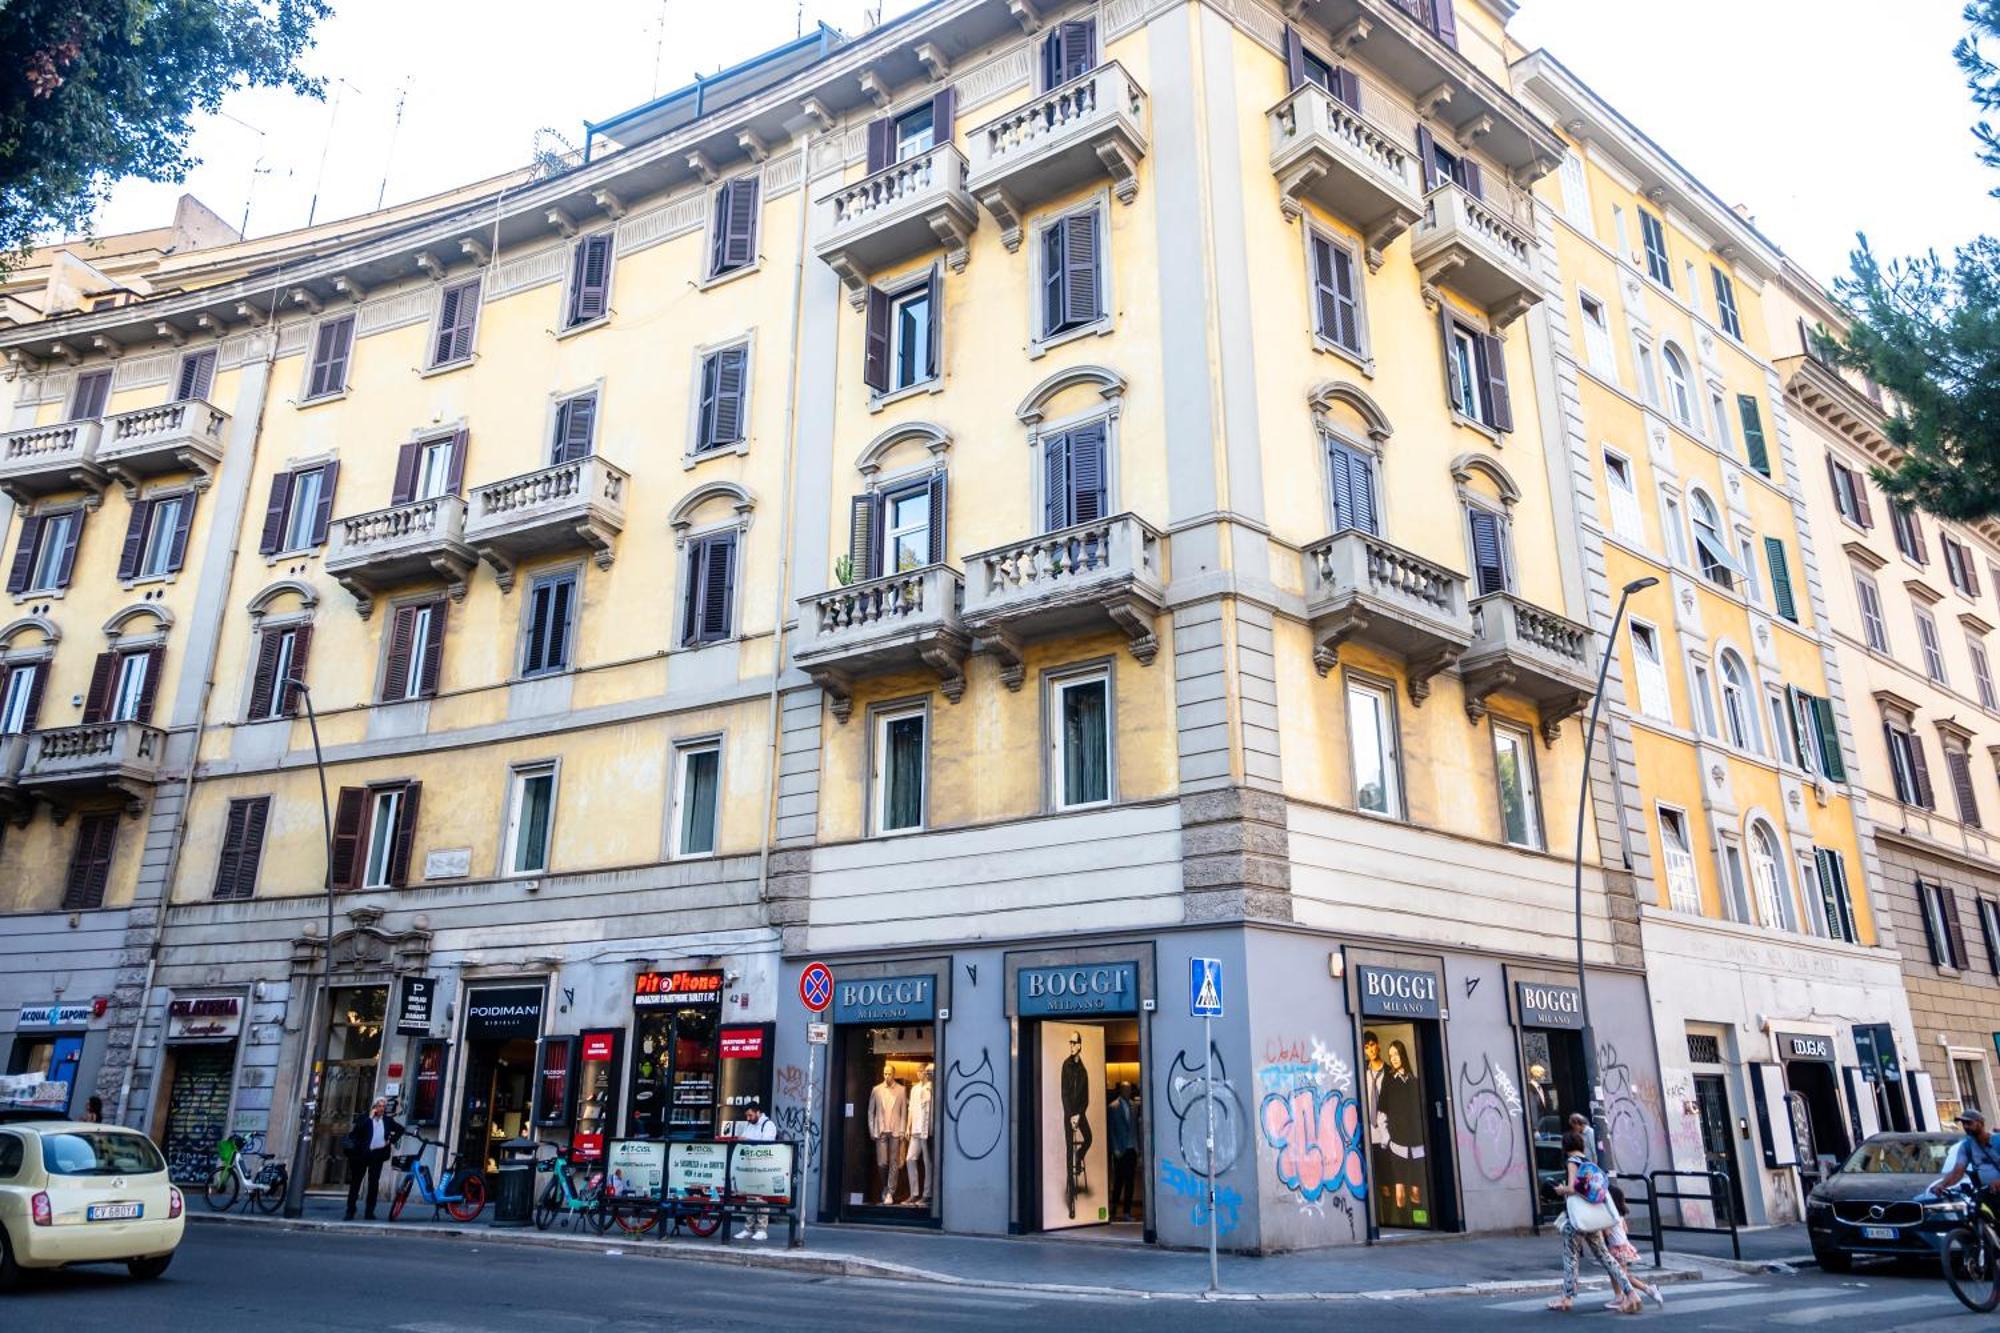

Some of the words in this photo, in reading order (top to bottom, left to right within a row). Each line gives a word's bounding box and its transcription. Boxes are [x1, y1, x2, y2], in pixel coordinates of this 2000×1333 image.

[636, 974, 660, 993] Pit
[671, 972, 720, 992] Phone
[1026, 969, 1125, 997] BOGGI
[1367, 972, 1435, 1001] BOGGI
[843, 980, 925, 1006] BOGGI
[1524, 986, 1579, 1013] BOGGI
[470, 1006, 538, 1017] POIDIMANI
[1047, 999, 1105, 1011] MILANO
[1383, 1001, 1424, 1013] MILANO
[858, 1008, 907, 1019] MILANO
[1537, 1013, 1570, 1025] MILANO
